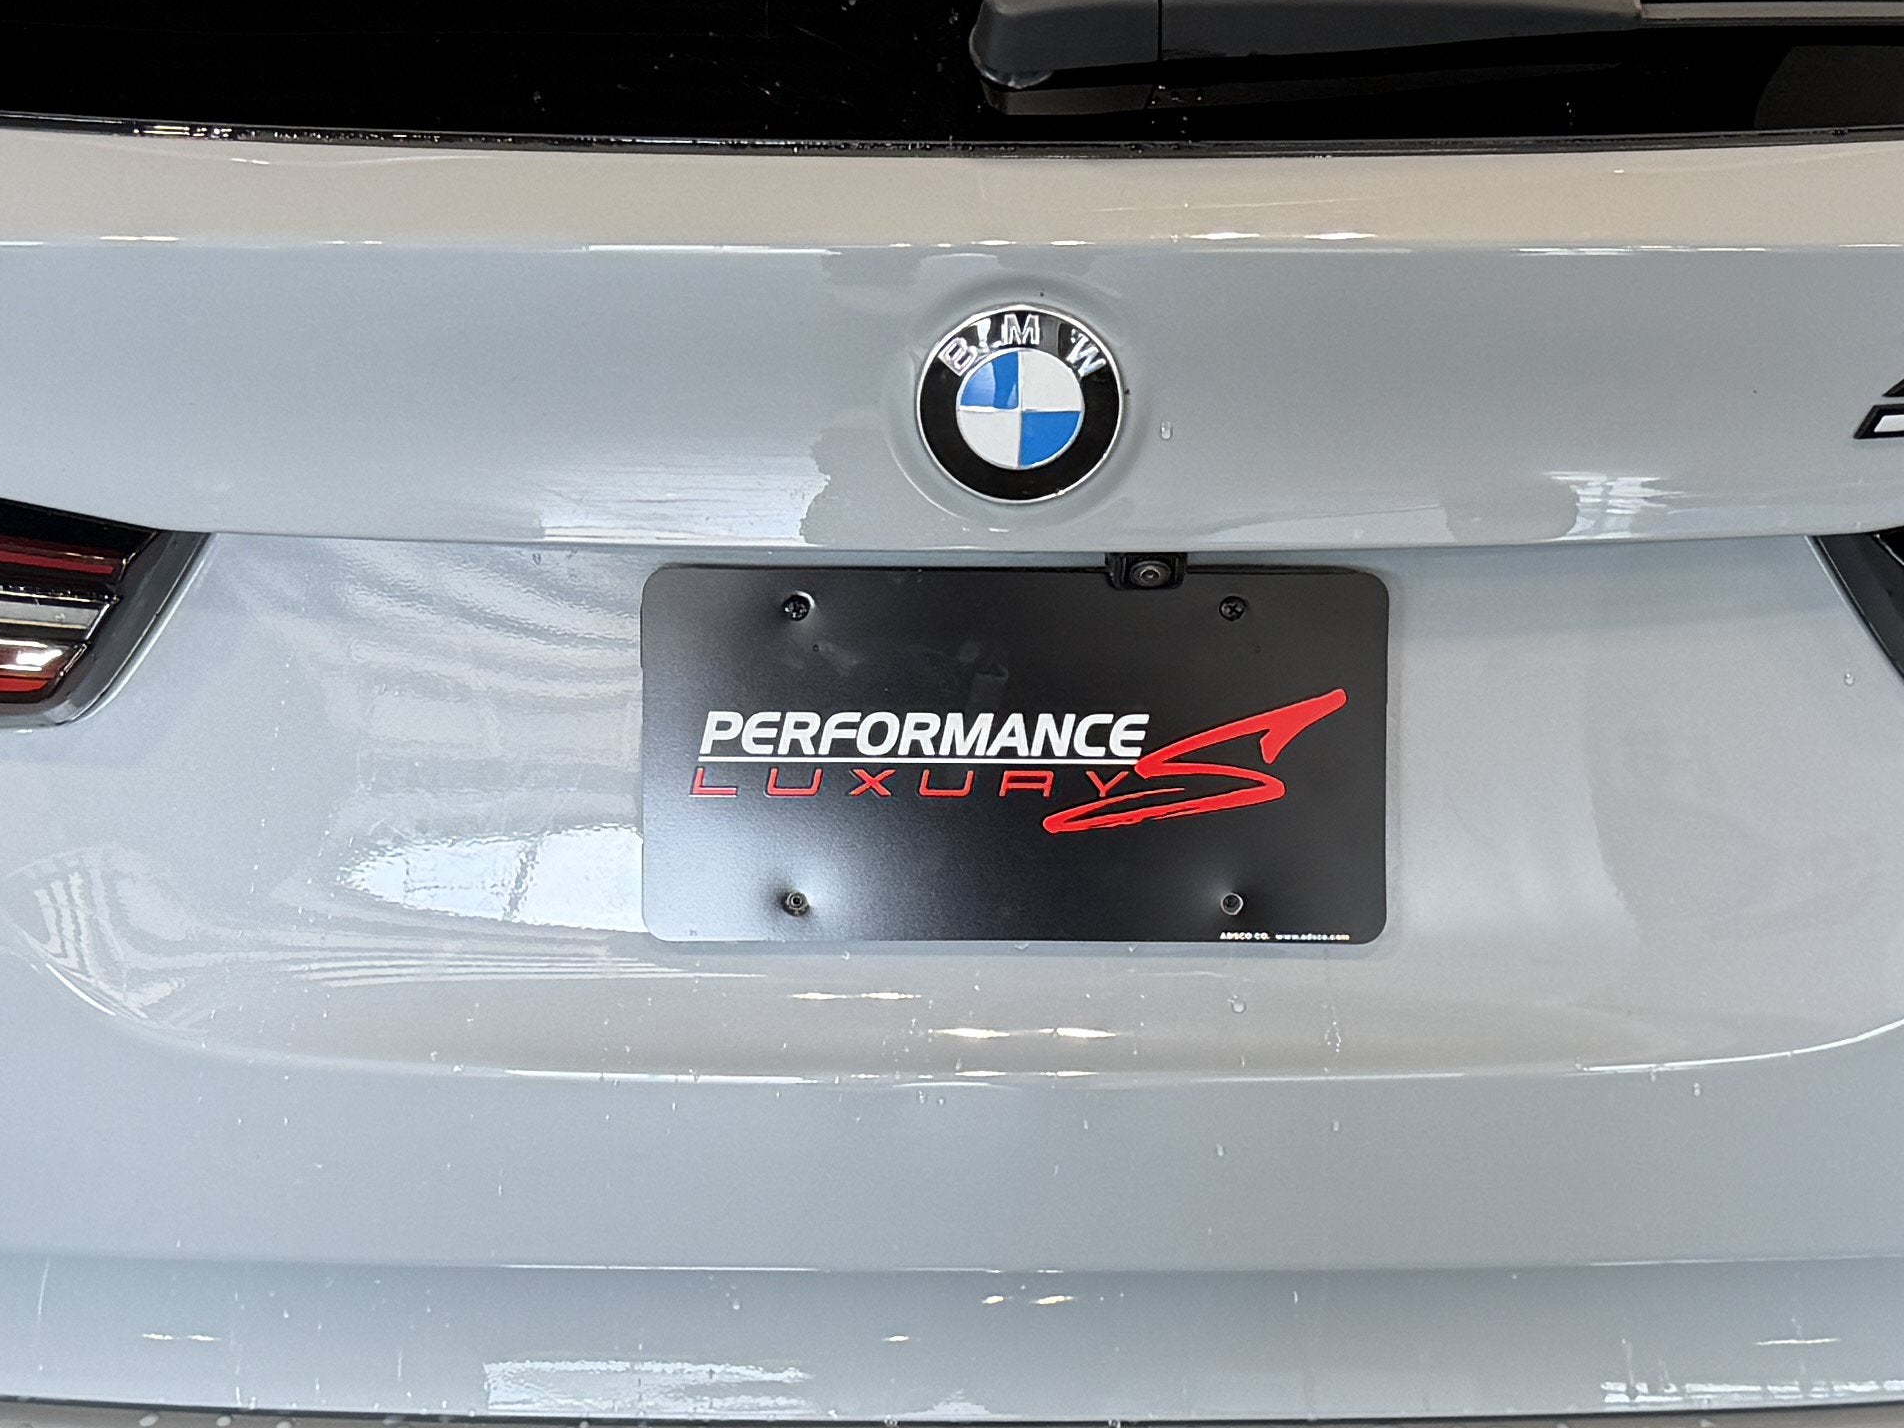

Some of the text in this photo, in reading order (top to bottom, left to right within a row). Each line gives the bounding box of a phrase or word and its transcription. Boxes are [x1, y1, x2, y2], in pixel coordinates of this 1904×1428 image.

[937, 313, 1106, 377] BMW
[699, 710, 1150, 757] PERFORMANCE
[688, 767, 1130, 798] LUXURY
